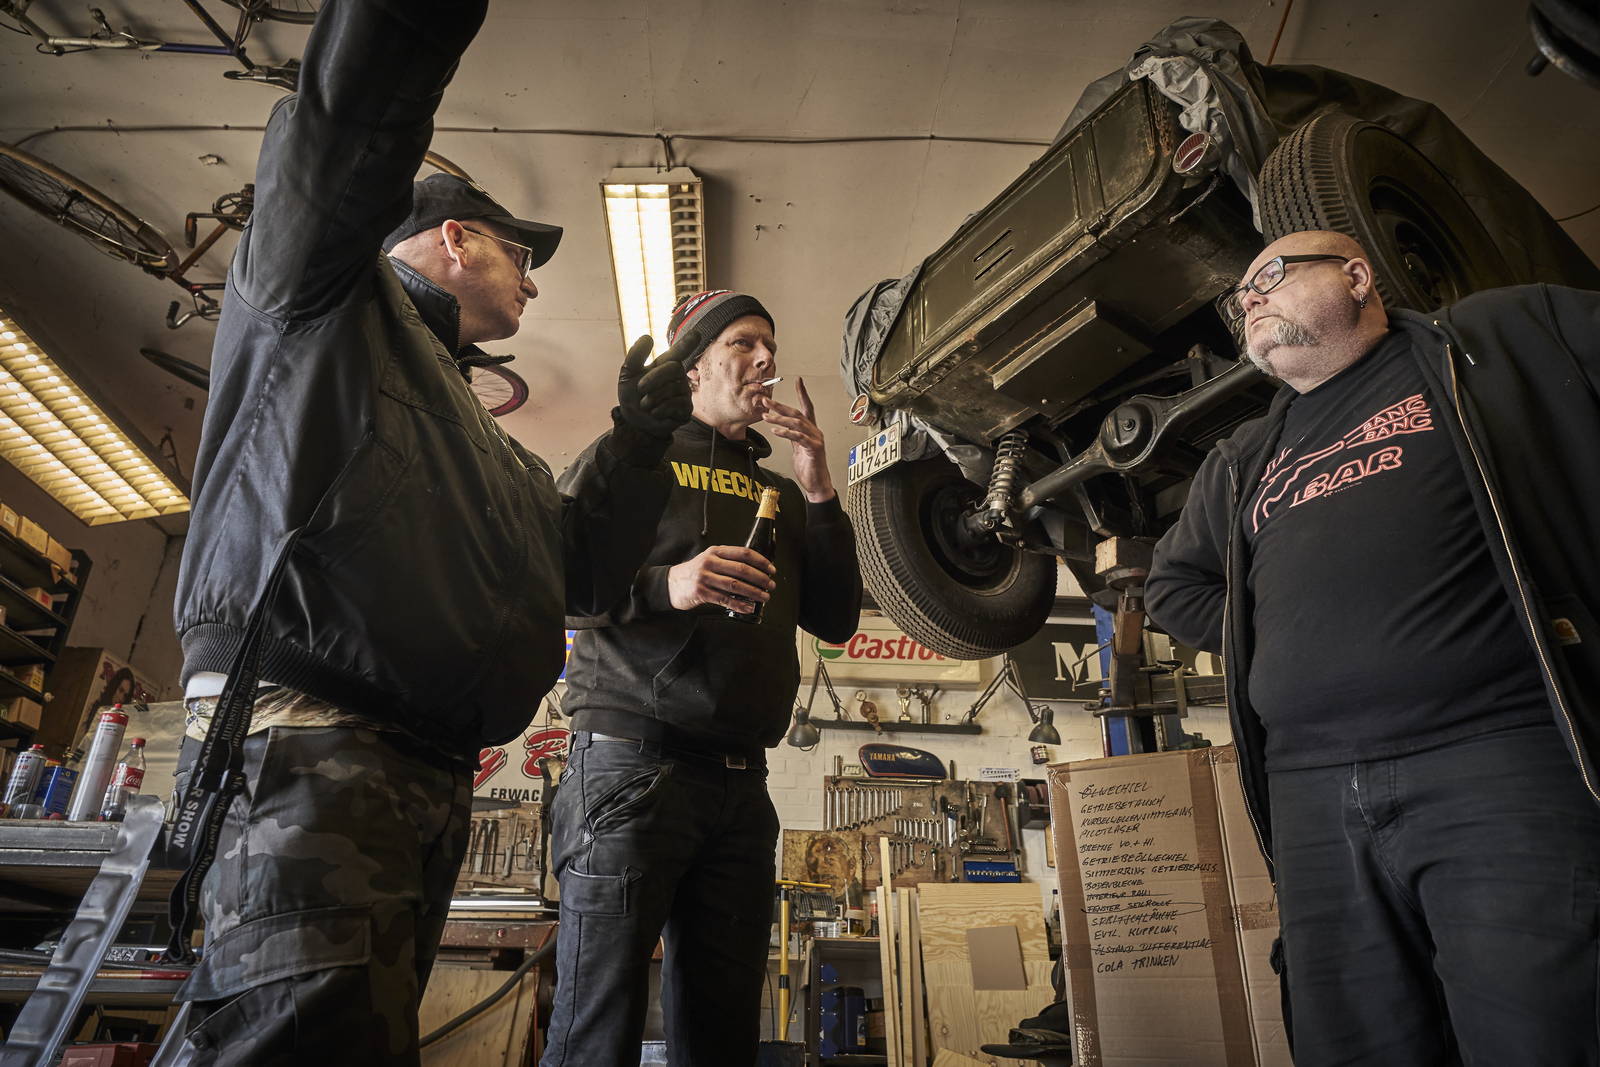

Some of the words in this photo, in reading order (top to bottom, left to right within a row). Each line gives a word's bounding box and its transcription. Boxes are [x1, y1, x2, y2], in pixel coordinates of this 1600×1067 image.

[1363, 400, 1426, 431] BANG
[1365, 412, 1432, 440] BANG
[861, 437, 877, 459] HH
[1290, 446, 1402, 507] BAR
[847, 633, 946, 662] Castro
[870, 752, 897, 762] YAMAHA
[173, 800, 199, 849] SHOW
[1097, 961, 1124, 974] COLA
[1131, 955, 1180, 971] TRINKEN
